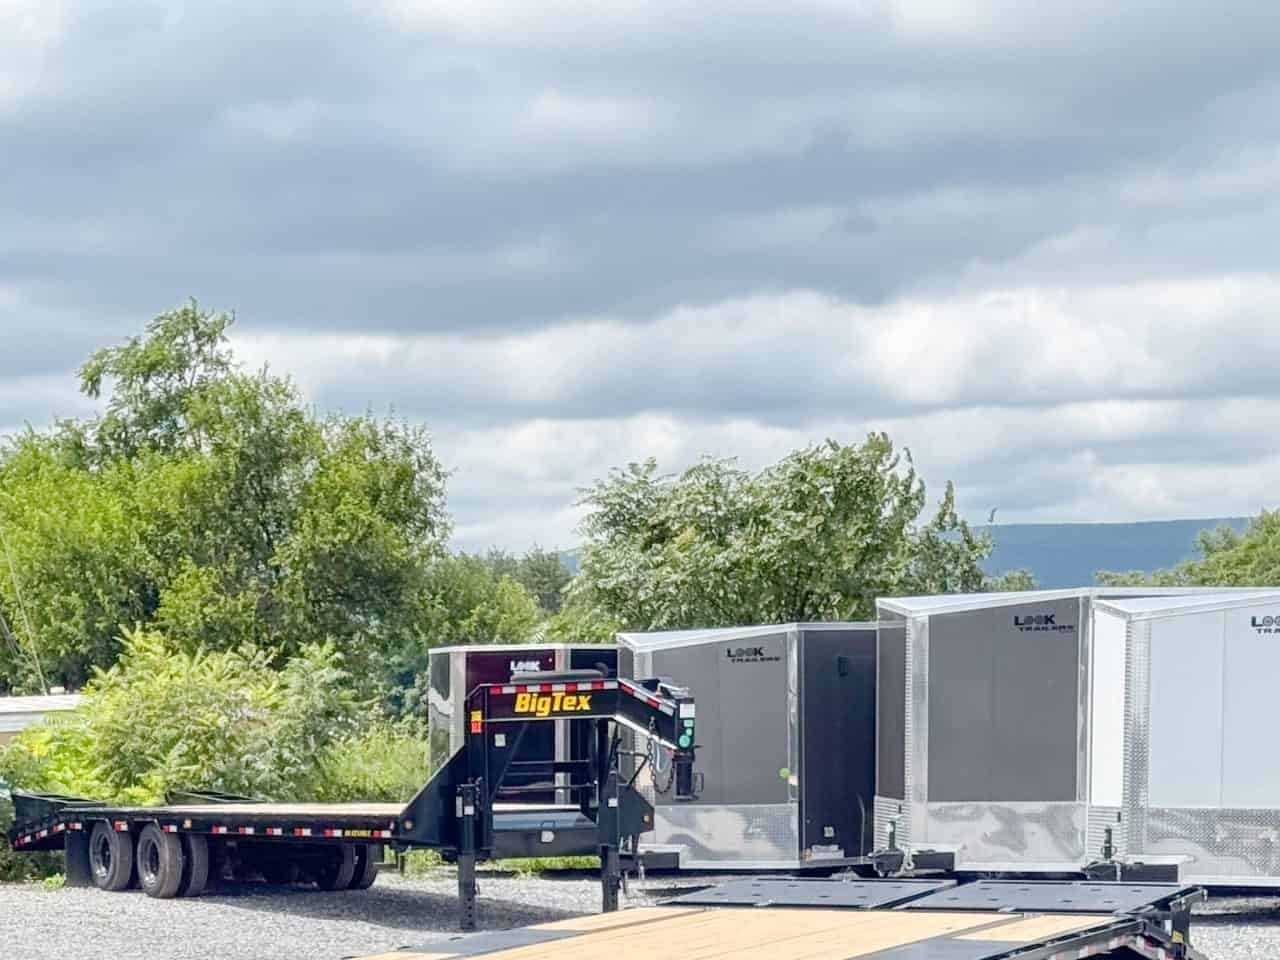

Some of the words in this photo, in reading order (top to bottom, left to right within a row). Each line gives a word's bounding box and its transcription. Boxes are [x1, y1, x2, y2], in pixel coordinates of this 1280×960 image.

[1014, 614, 1055, 625] LOOK
[727, 647, 764, 658] LOOK
[514, 691, 592, 716] BigTex
